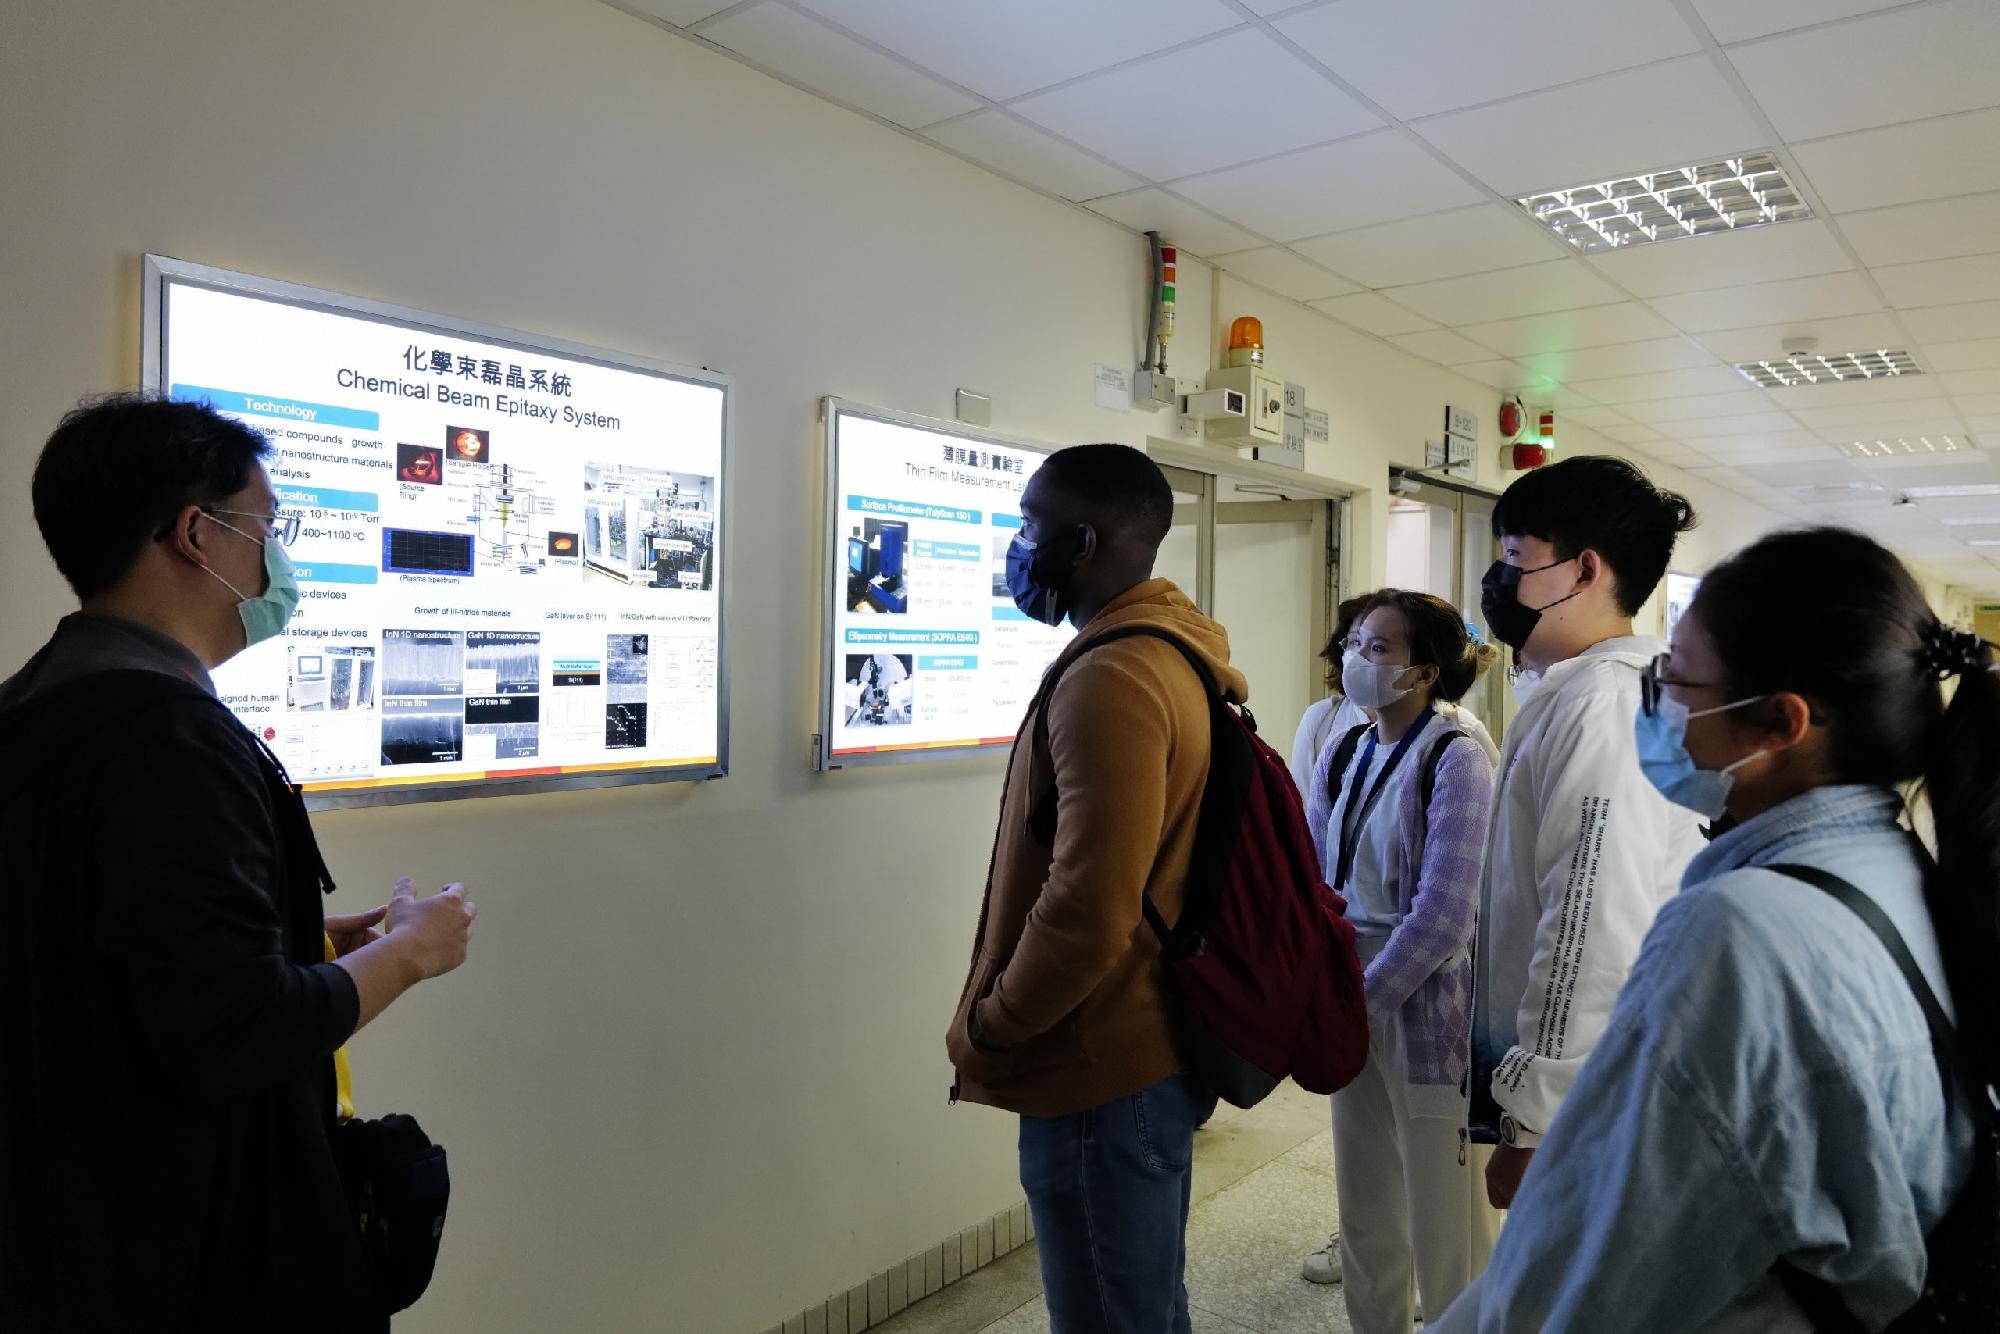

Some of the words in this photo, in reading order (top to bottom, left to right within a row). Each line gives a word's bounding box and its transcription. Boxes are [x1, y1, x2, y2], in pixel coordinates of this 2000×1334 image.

[403, 344, 572, 397] 化學束磊晶系統
[337, 368, 430, 400] Chemical
[437, 384, 490, 410] Beam
[496, 394, 558, 424] Epitaxy
[563, 405, 620, 430] System
[244, 397, 318, 421] Technology
[286, 429, 343, 444] compounds
[351, 438, 383, 450] growth
[281, 449, 349, 464] nanostructure
[351, 457, 393, 469] materials
[269, 467, 311, 480] analysis
[905, 462, 926, 477] Thin
[929, 466, 948, 481] Film
[952, 470, 1010, 490] Measurement
[275, 487, 318, 503] fication
[275, 508, 306, 518] ssure:
[360, 512, 380, 523] Torr
[309, 589, 347, 600] devices
[414, 607, 439, 615] Growth
[442, 607, 449, 615] of
[481, 609, 511, 617] materials
[292, 627, 328, 638] storage
[332, 628, 368, 638] devices
[385, 631, 400, 639] InN
[401, 631, 412, 639] 1D
[220, 694, 248, 703] signed
[251, 694, 280, 702] human
[1579, 835, 1591, 870] OUTSIDE
[1589, 858, 1598, 876] HAS
[1576, 870, 1585, 887] THE
[1585, 877, 1595, 898] ALSO
[1581, 900, 1591, 922] BEEN
[1577, 923, 1587, 945] USED
[1558, 961, 1569, 982] SUCH
[1555, 983, 1563, 995] AS
